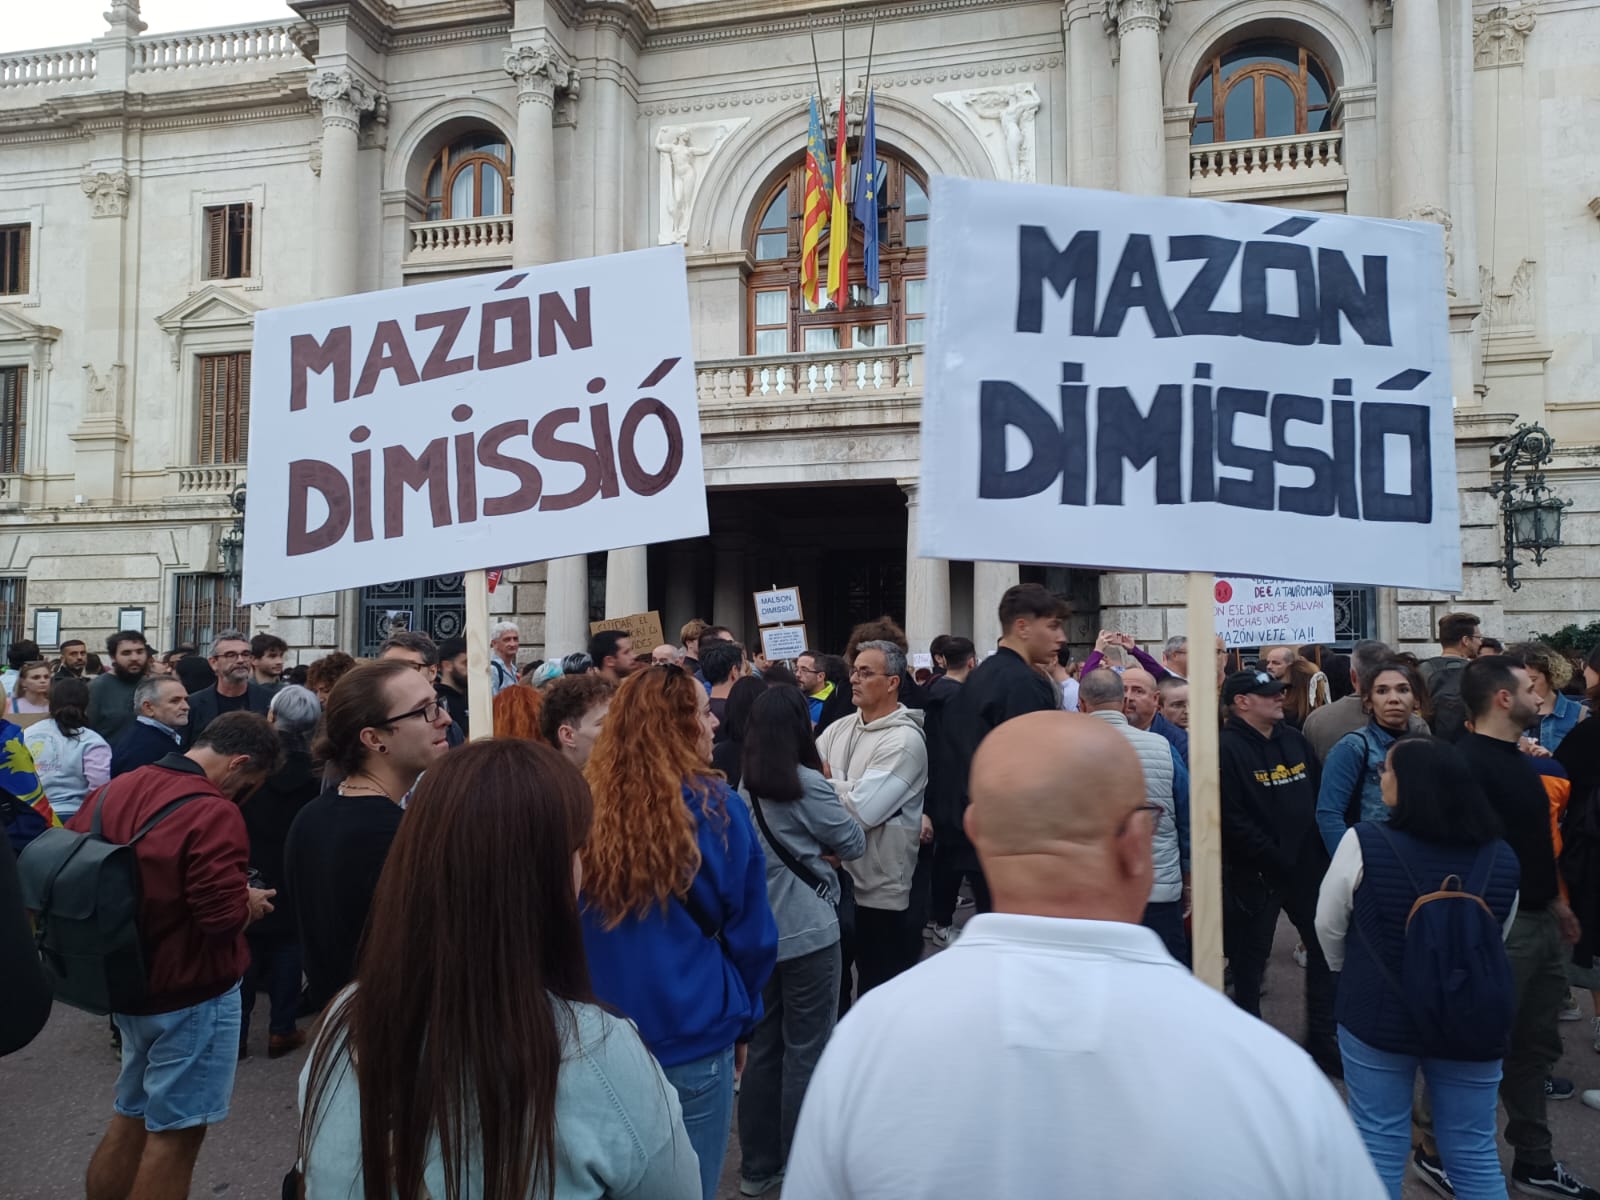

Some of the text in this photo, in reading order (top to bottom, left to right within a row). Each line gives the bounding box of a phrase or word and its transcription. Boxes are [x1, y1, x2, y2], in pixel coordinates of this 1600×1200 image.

[1015, 216, 1393, 347] MAZÓN
[290, 272, 593, 412] MAZÓN
[1274, 586, 1281, 598] A
[1281, 584, 1333, 598] TAUROMAQUIA
[1228, 604, 1245, 616] ESE
[1277, 602, 1288, 611] SE
[1290, 600, 1323, 611] SALVAN
[1227, 616, 1263, 629] MUCHAS
[1258, 629, 1286, 641] VETE
[1292, 625, 1315, 642] YA!!
